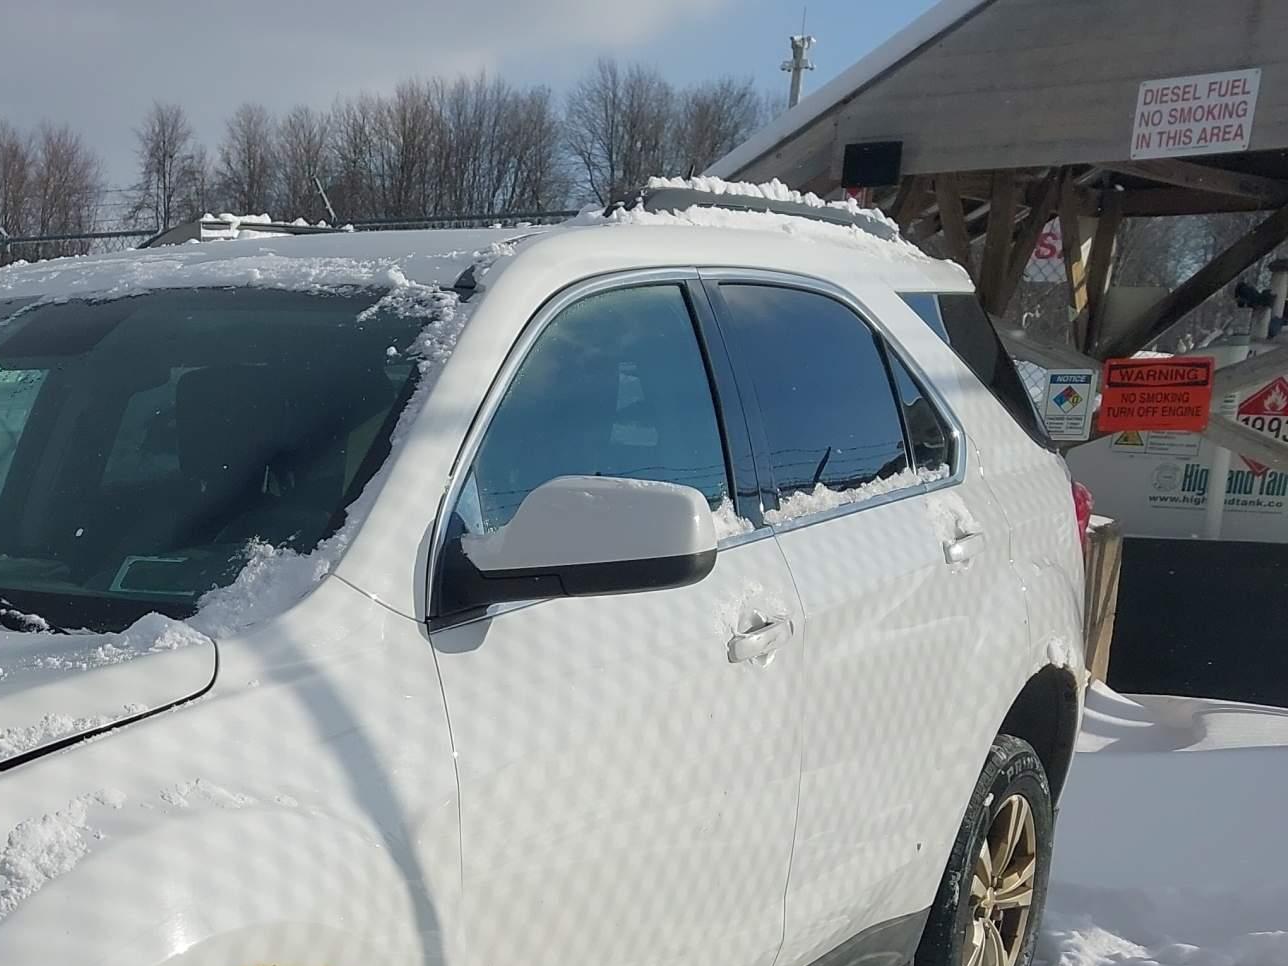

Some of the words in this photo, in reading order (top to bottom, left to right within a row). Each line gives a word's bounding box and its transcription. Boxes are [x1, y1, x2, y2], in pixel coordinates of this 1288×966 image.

[1143, 84, 1201, 106] DIESEL
[1207, 78, 1251, 99] FUEL
[1139, 110, 1163, 128] NO
[1167, 100, 1249, 125] SMOKING
[1135, 132, 1152, 150] IN
[1157, 128, 1193, 148] THIS
[1197, 123, 1245, 145] AREA
[1056, 375, 1087, 383] NOTICE
[1119, 368, 1199, 382] WARNING
[1121, 392, 1137, 404] NO
[1139, 392, 1190, 404] SMOKING
[1106, 407, 1135, 418] TURN
[1138, 406, 1159, 417] OFF
[1162, 406, 1202, 417] ENGINE
